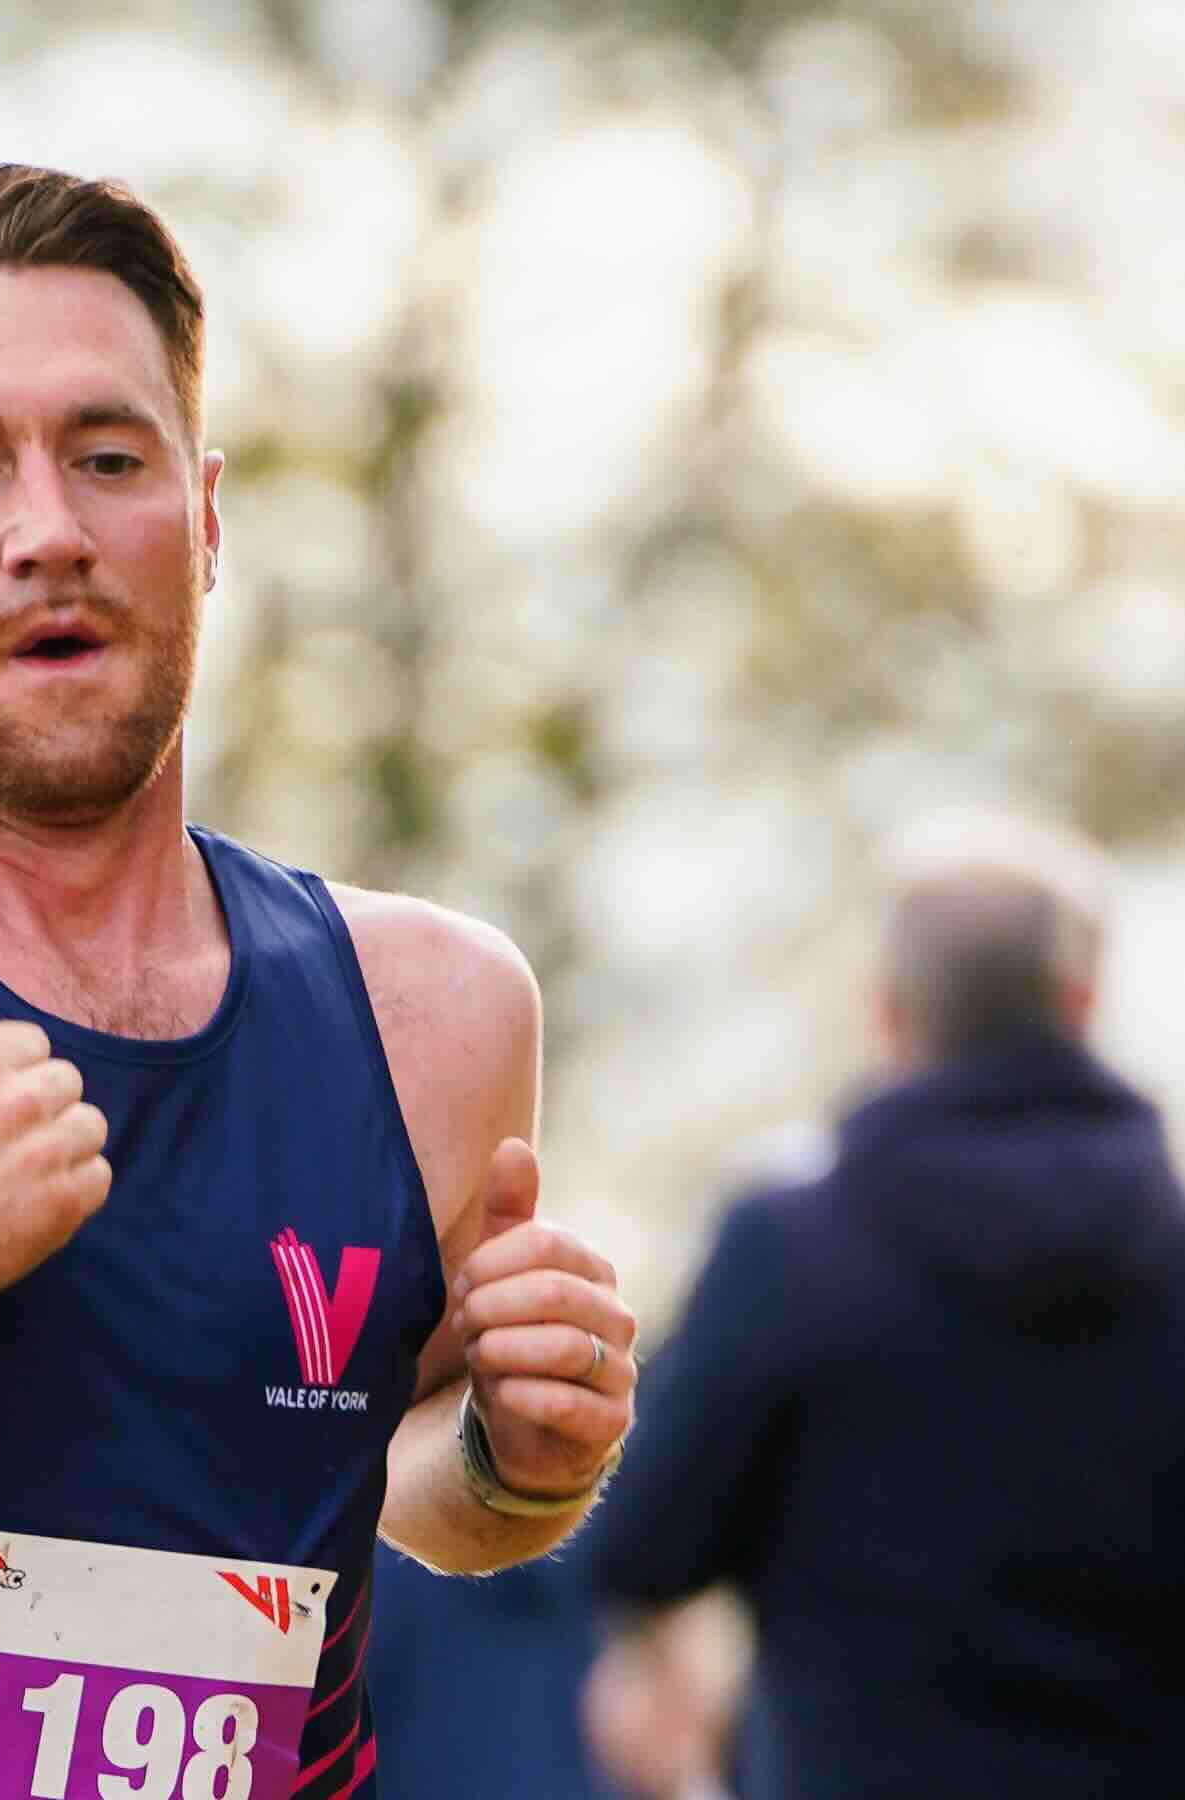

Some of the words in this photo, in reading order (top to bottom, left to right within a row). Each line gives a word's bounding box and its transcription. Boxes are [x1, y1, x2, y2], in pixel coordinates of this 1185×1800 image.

[265, 1385, 306, 1408] VALE
[308, 1388, 329, 1409] OF
[331, 1390, 368, 1410] YORK
